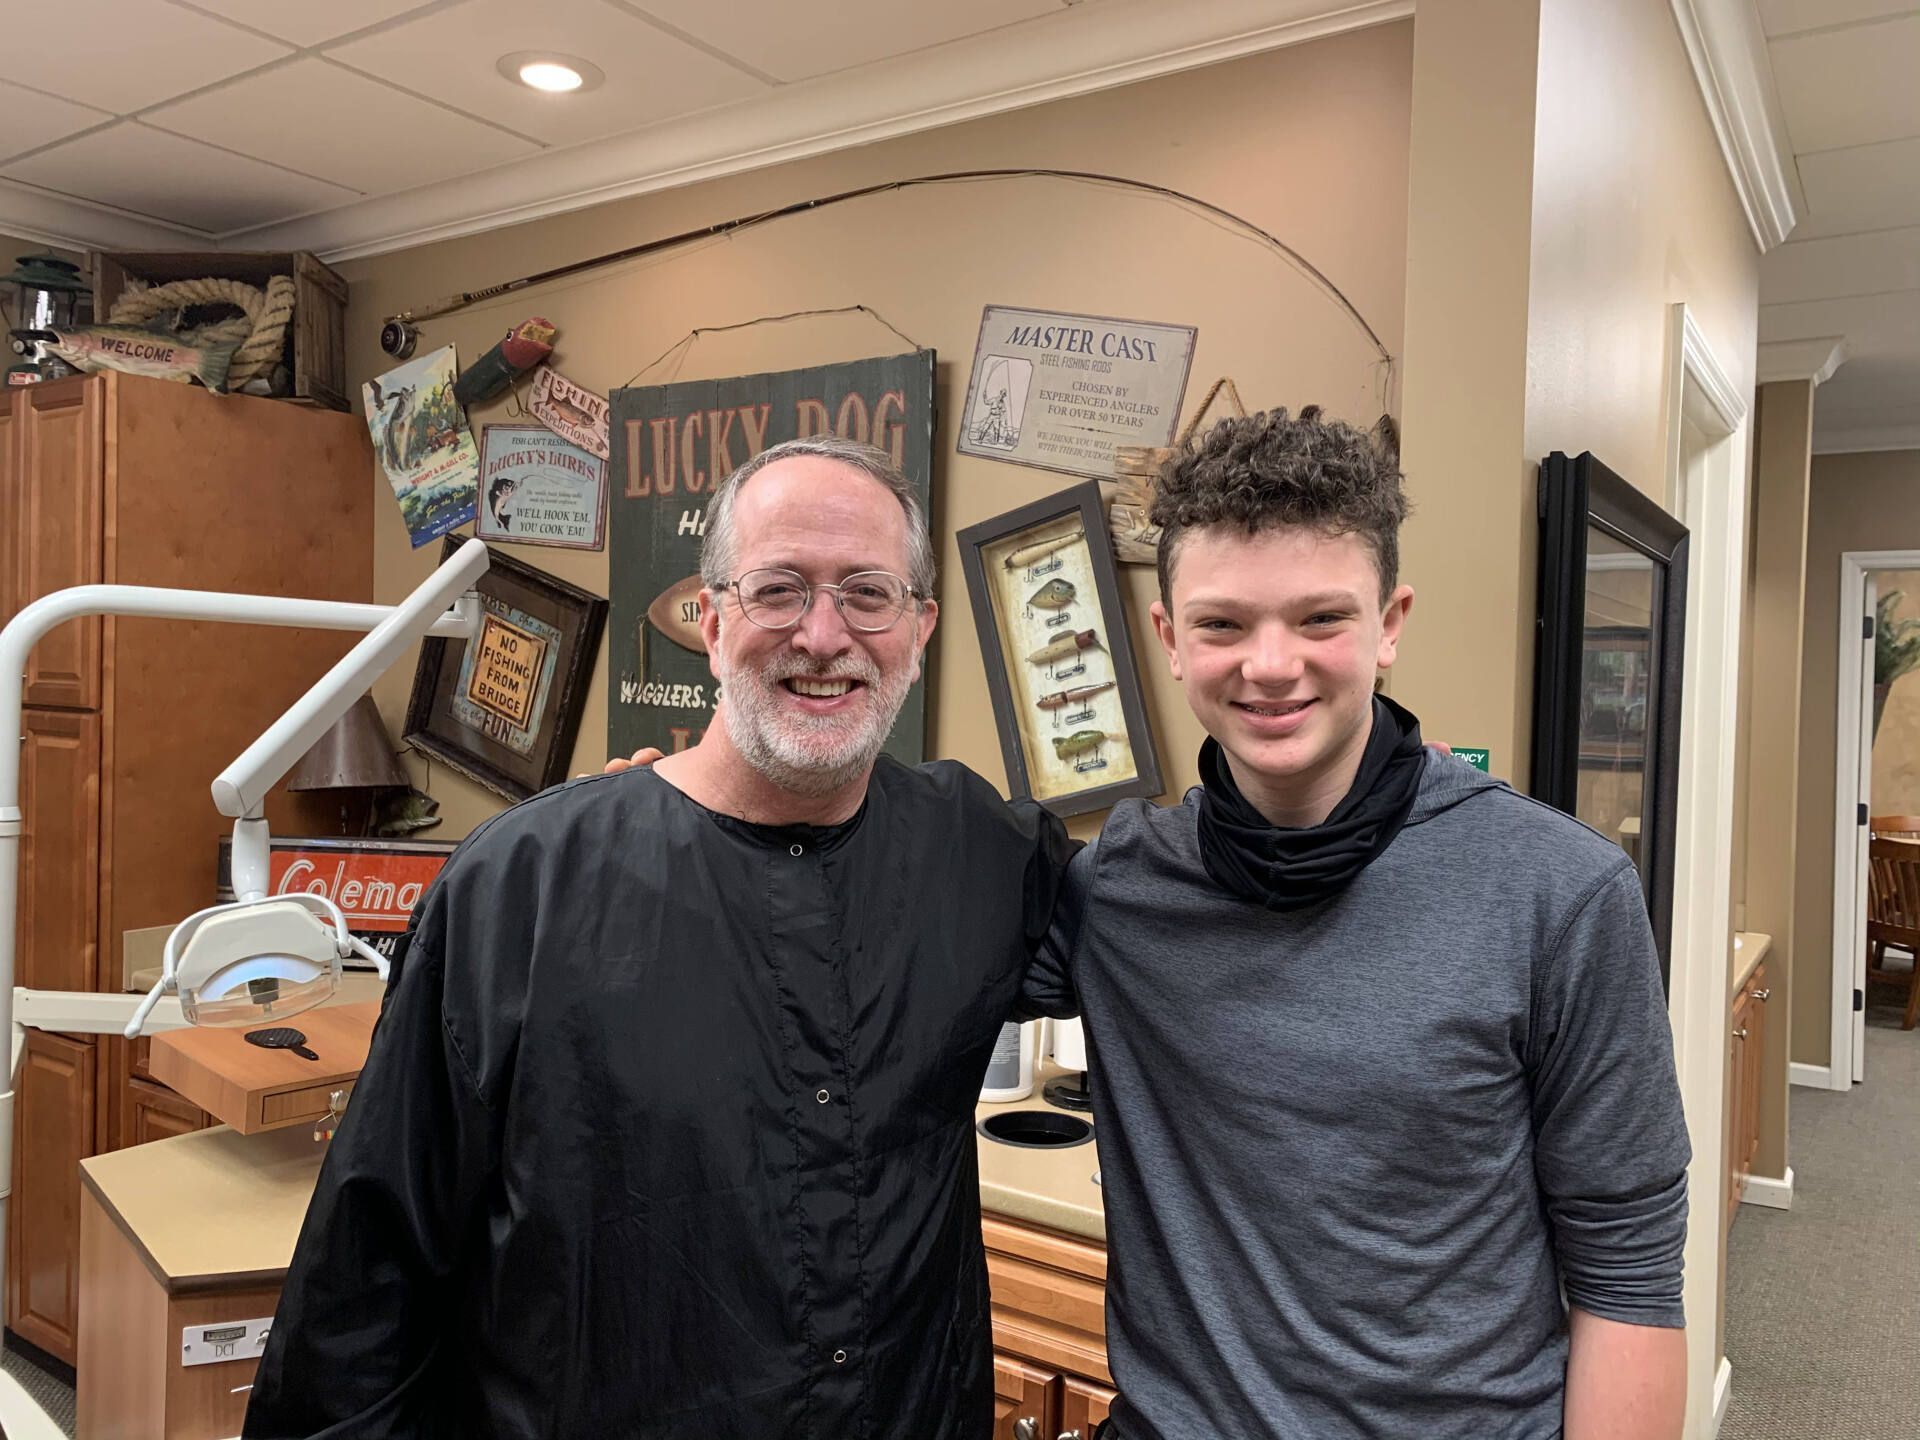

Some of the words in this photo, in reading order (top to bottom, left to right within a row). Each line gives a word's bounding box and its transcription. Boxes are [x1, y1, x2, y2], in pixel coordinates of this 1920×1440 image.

[101, 337, 174, 362] WELCOME
[1005, 326, 1094, 355] MASTER
[1100, 332, 1157, 362] CAST
[1040, 353, 1060, 368] STEEL
[1061, 356, 1091, 371] FISHING
[1091, 359, 1113, 374] RODS
[1072, 381, 1113, 396] CHOSEN
[1115, 385, 1129, 398] BY
[1039, 390, 1109, 409] EXPERIENCED
[1110, 400, 1160, 416] ANGLERS
[540, 408, 594, 446] EXPEDITIONS
[1047, 405, 1069, 418] FOR
[1069, 407, 1097, 421] OVER
[1098, 411, 1109, 422] 50
[1110, 413, 1144, 428] YEARS
[512, 437, 527, 446] FISH
[527, 438, 546, 447] CAN'T
[624, 403, 772, 498] LUCKY
[488, 449, 546, 476] LUCKY'S
[548, 451, 596, 482] LURES
[516, 508, 542, 519] WE'LL
[543, 510, 570, 522] HOOK
[520, 522, 538, 533] YOU
[540, 523, 564, 536] COOK
[566, 525, 585, 537] 'EM!
[500, 635, 518, 654] NO
[484, 647, 530, 680] FISHING
[486, 667, 520, 693] FROM
[478, 683, 521, 714] BRIDGE
[620, 680, 707, 710] WIGGLERS,
[481, 711, 513, 744] FUN
[1450, 752, 1485, 763] NCY
[215, 1343, 234, 1357] DCI
